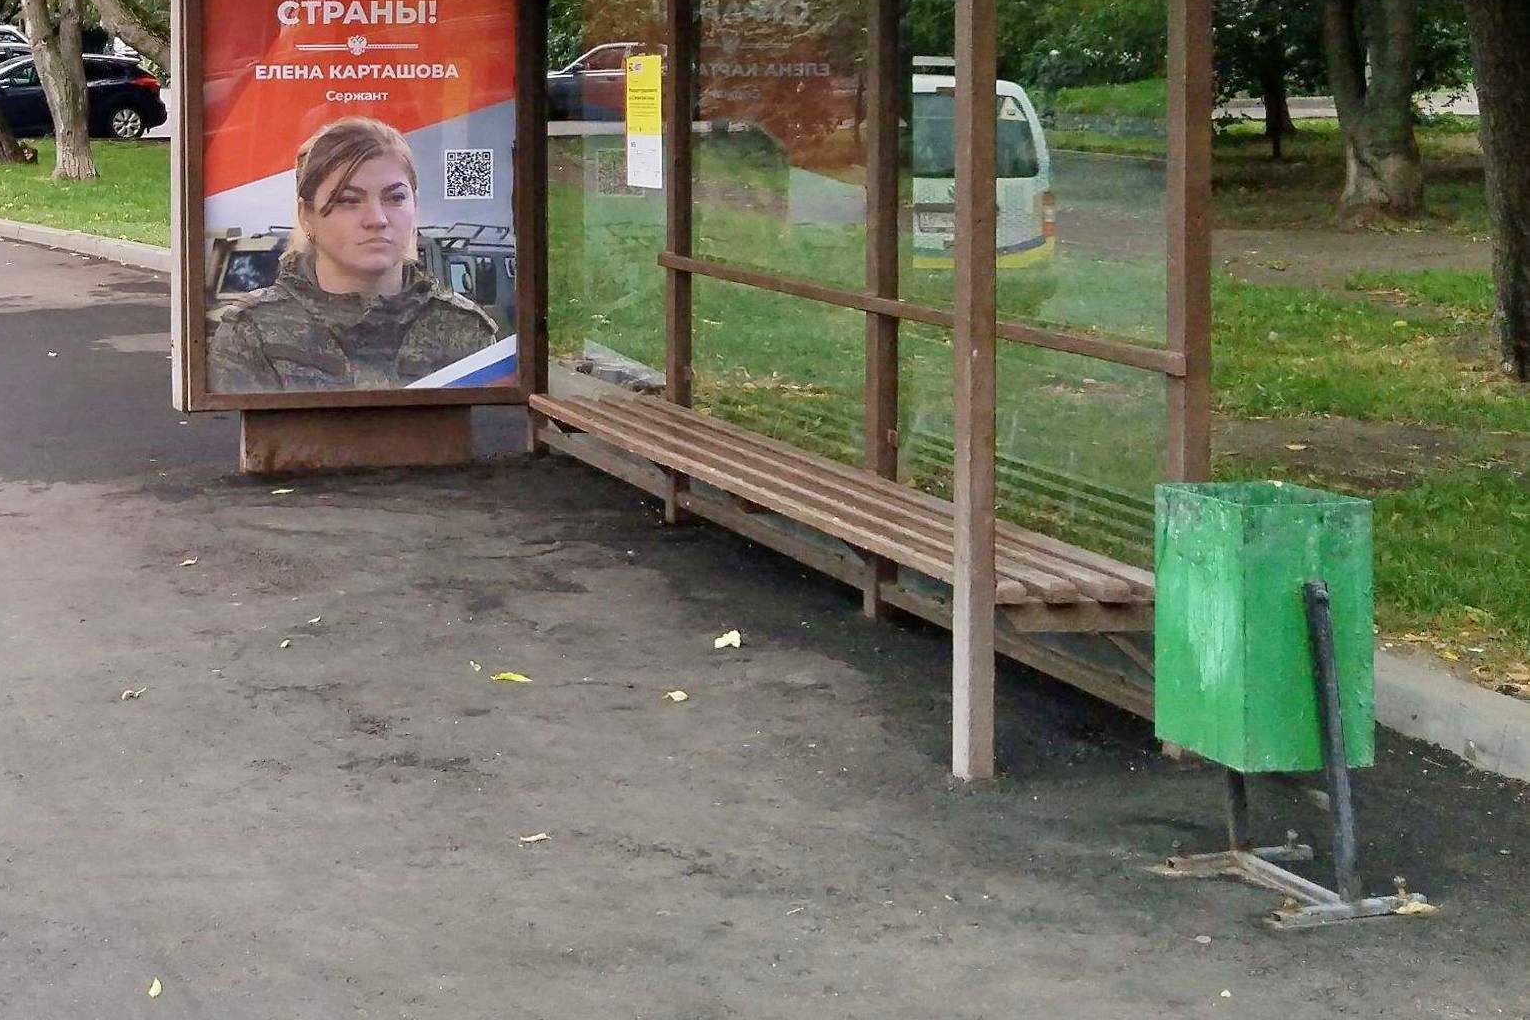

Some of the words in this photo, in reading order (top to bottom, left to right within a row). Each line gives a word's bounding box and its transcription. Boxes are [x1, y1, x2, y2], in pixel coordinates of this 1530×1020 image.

[276, 0, 438, 25] СТРАНЫ!
[255, 64, 324, 80] ЕЛЕНА
[329, 63, 460, 80] КАРТАШОВА
[325, 90, 389, 103] Сержант
